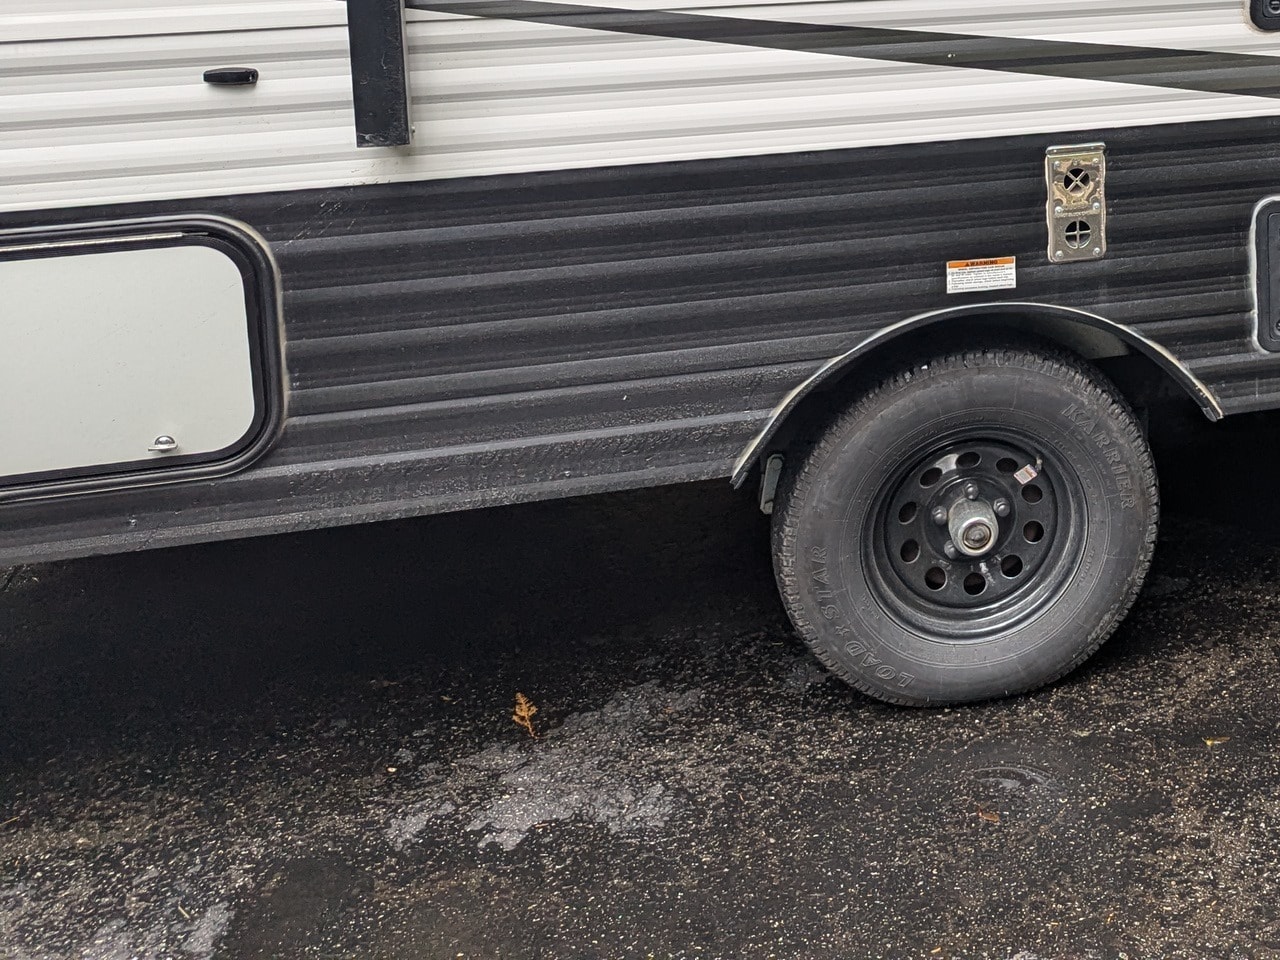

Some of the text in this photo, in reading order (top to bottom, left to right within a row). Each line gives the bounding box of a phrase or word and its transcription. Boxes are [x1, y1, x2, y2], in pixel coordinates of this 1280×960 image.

[1061, 403, 1137, 510] KARRIER
[811, 546, 916, 688] LOAD STAR
